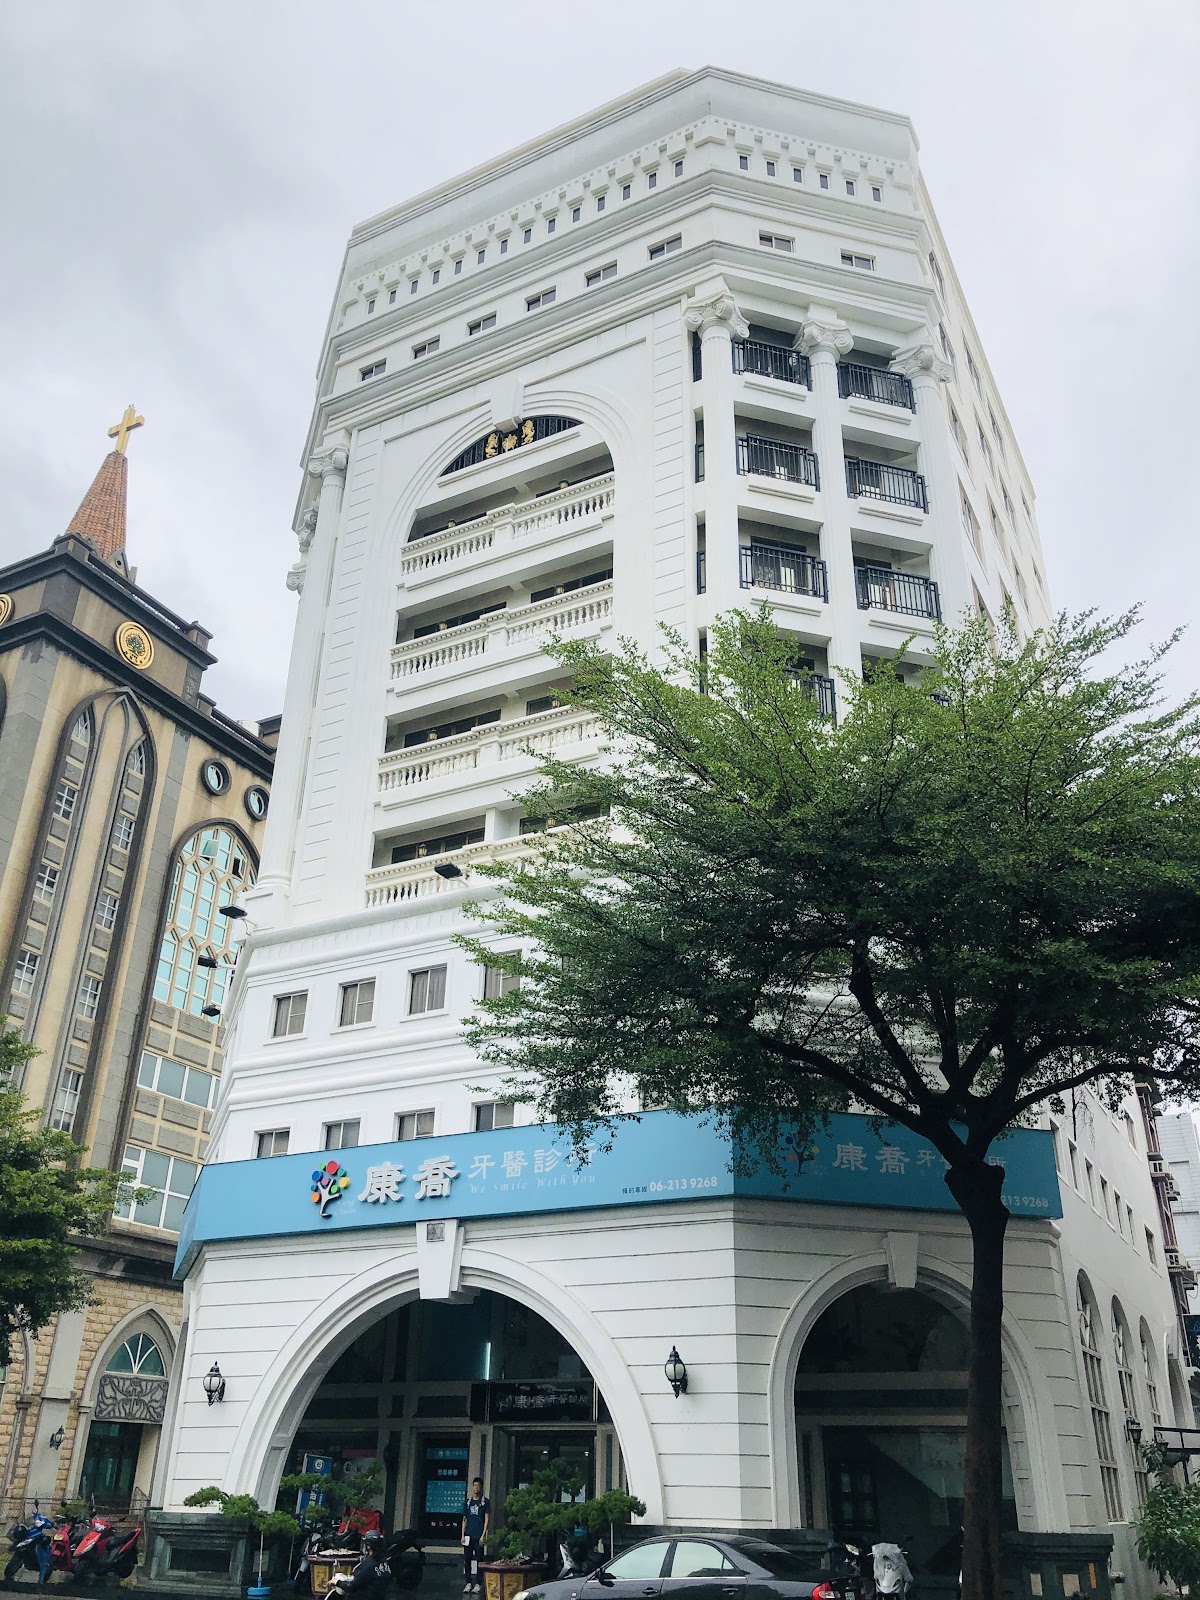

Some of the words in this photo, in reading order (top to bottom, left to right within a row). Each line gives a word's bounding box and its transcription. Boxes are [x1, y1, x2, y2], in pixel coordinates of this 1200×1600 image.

[832, 1142, 910, 1174] 康喬
[358, 1156, 461, 1204] 康喬
[649, 1179, 688, 1192] 06-213
[690, 1176, 718, 1189] 9268
[1000, 1195, 1020, 1207] 213
